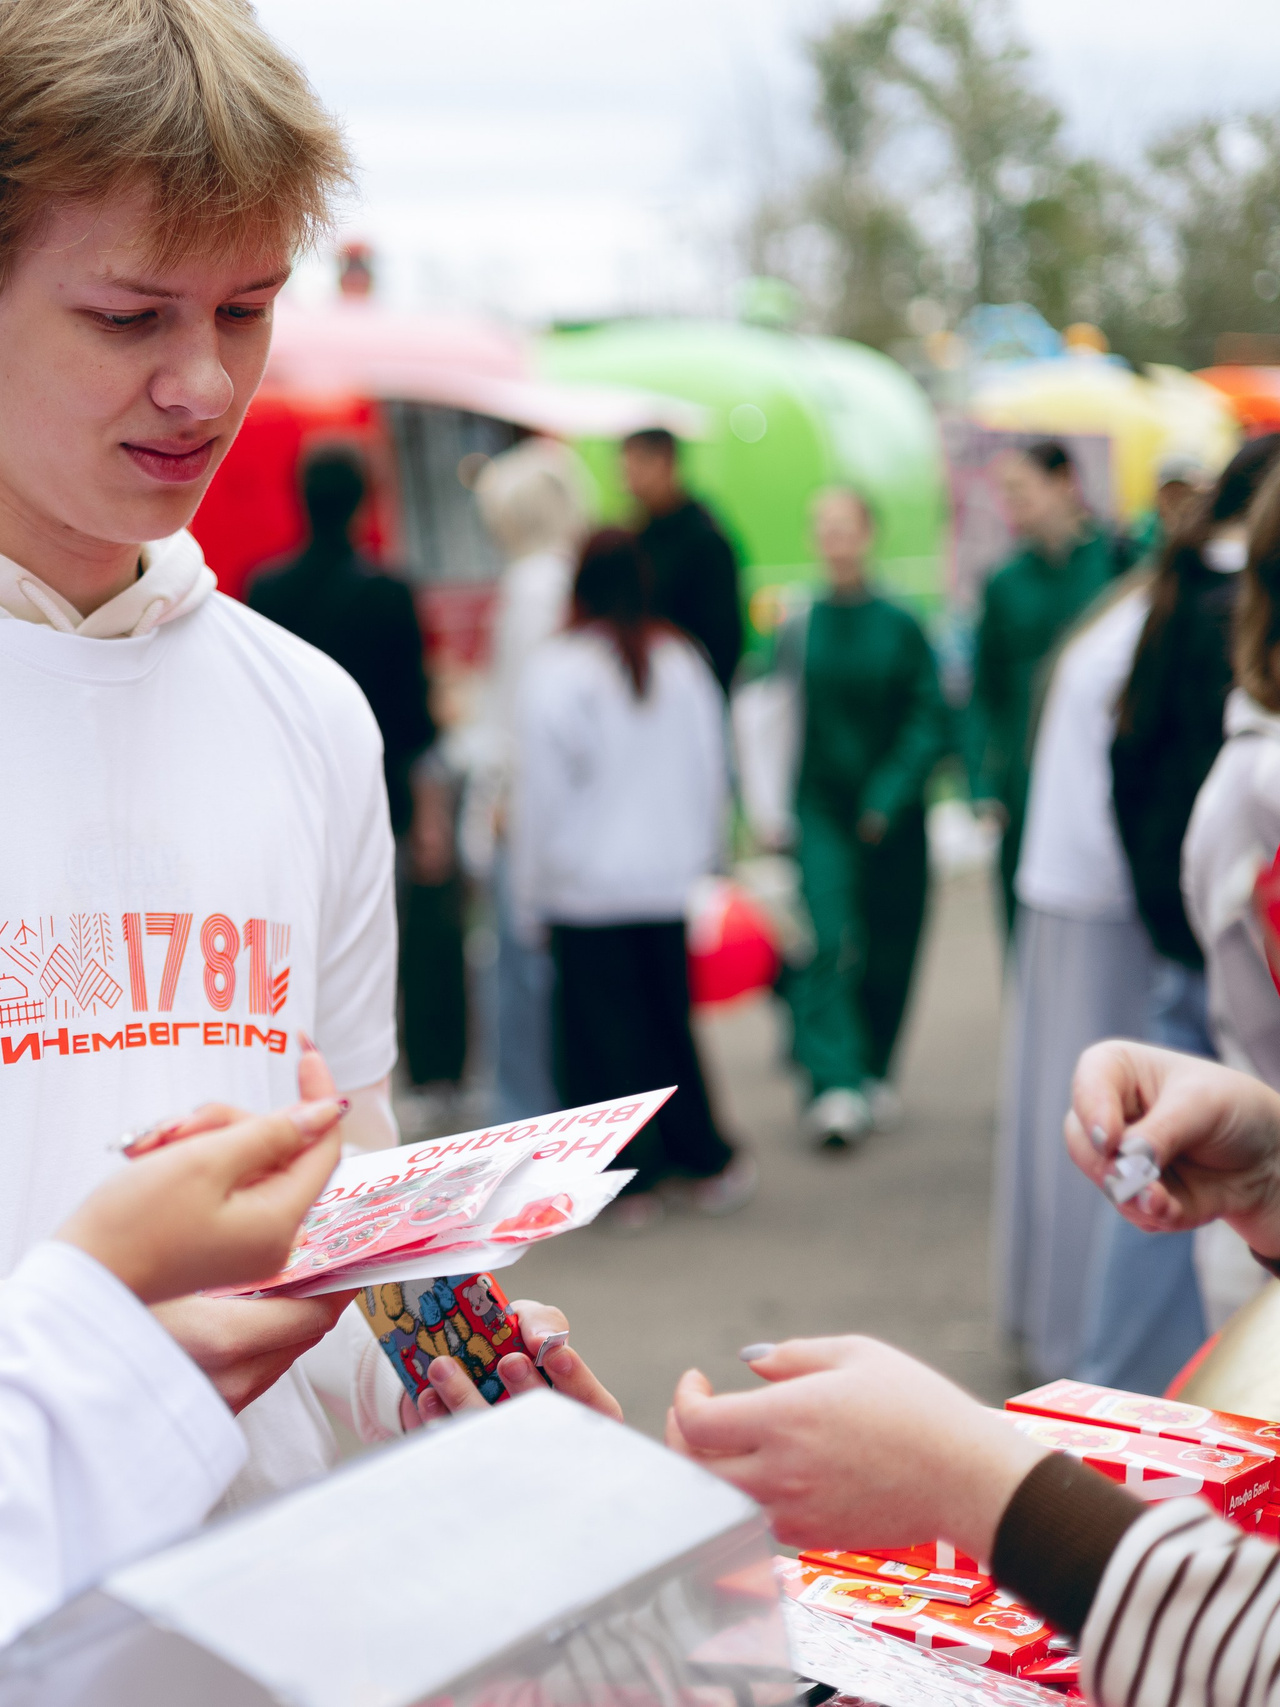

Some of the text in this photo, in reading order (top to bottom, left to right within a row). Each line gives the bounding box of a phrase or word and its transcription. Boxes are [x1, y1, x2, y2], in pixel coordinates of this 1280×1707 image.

[122, 912, 267, 1015] 1781
[532, 1131, 617, 1163] Не
[1228, 1480, 1271, 1511] Альфа Банк
